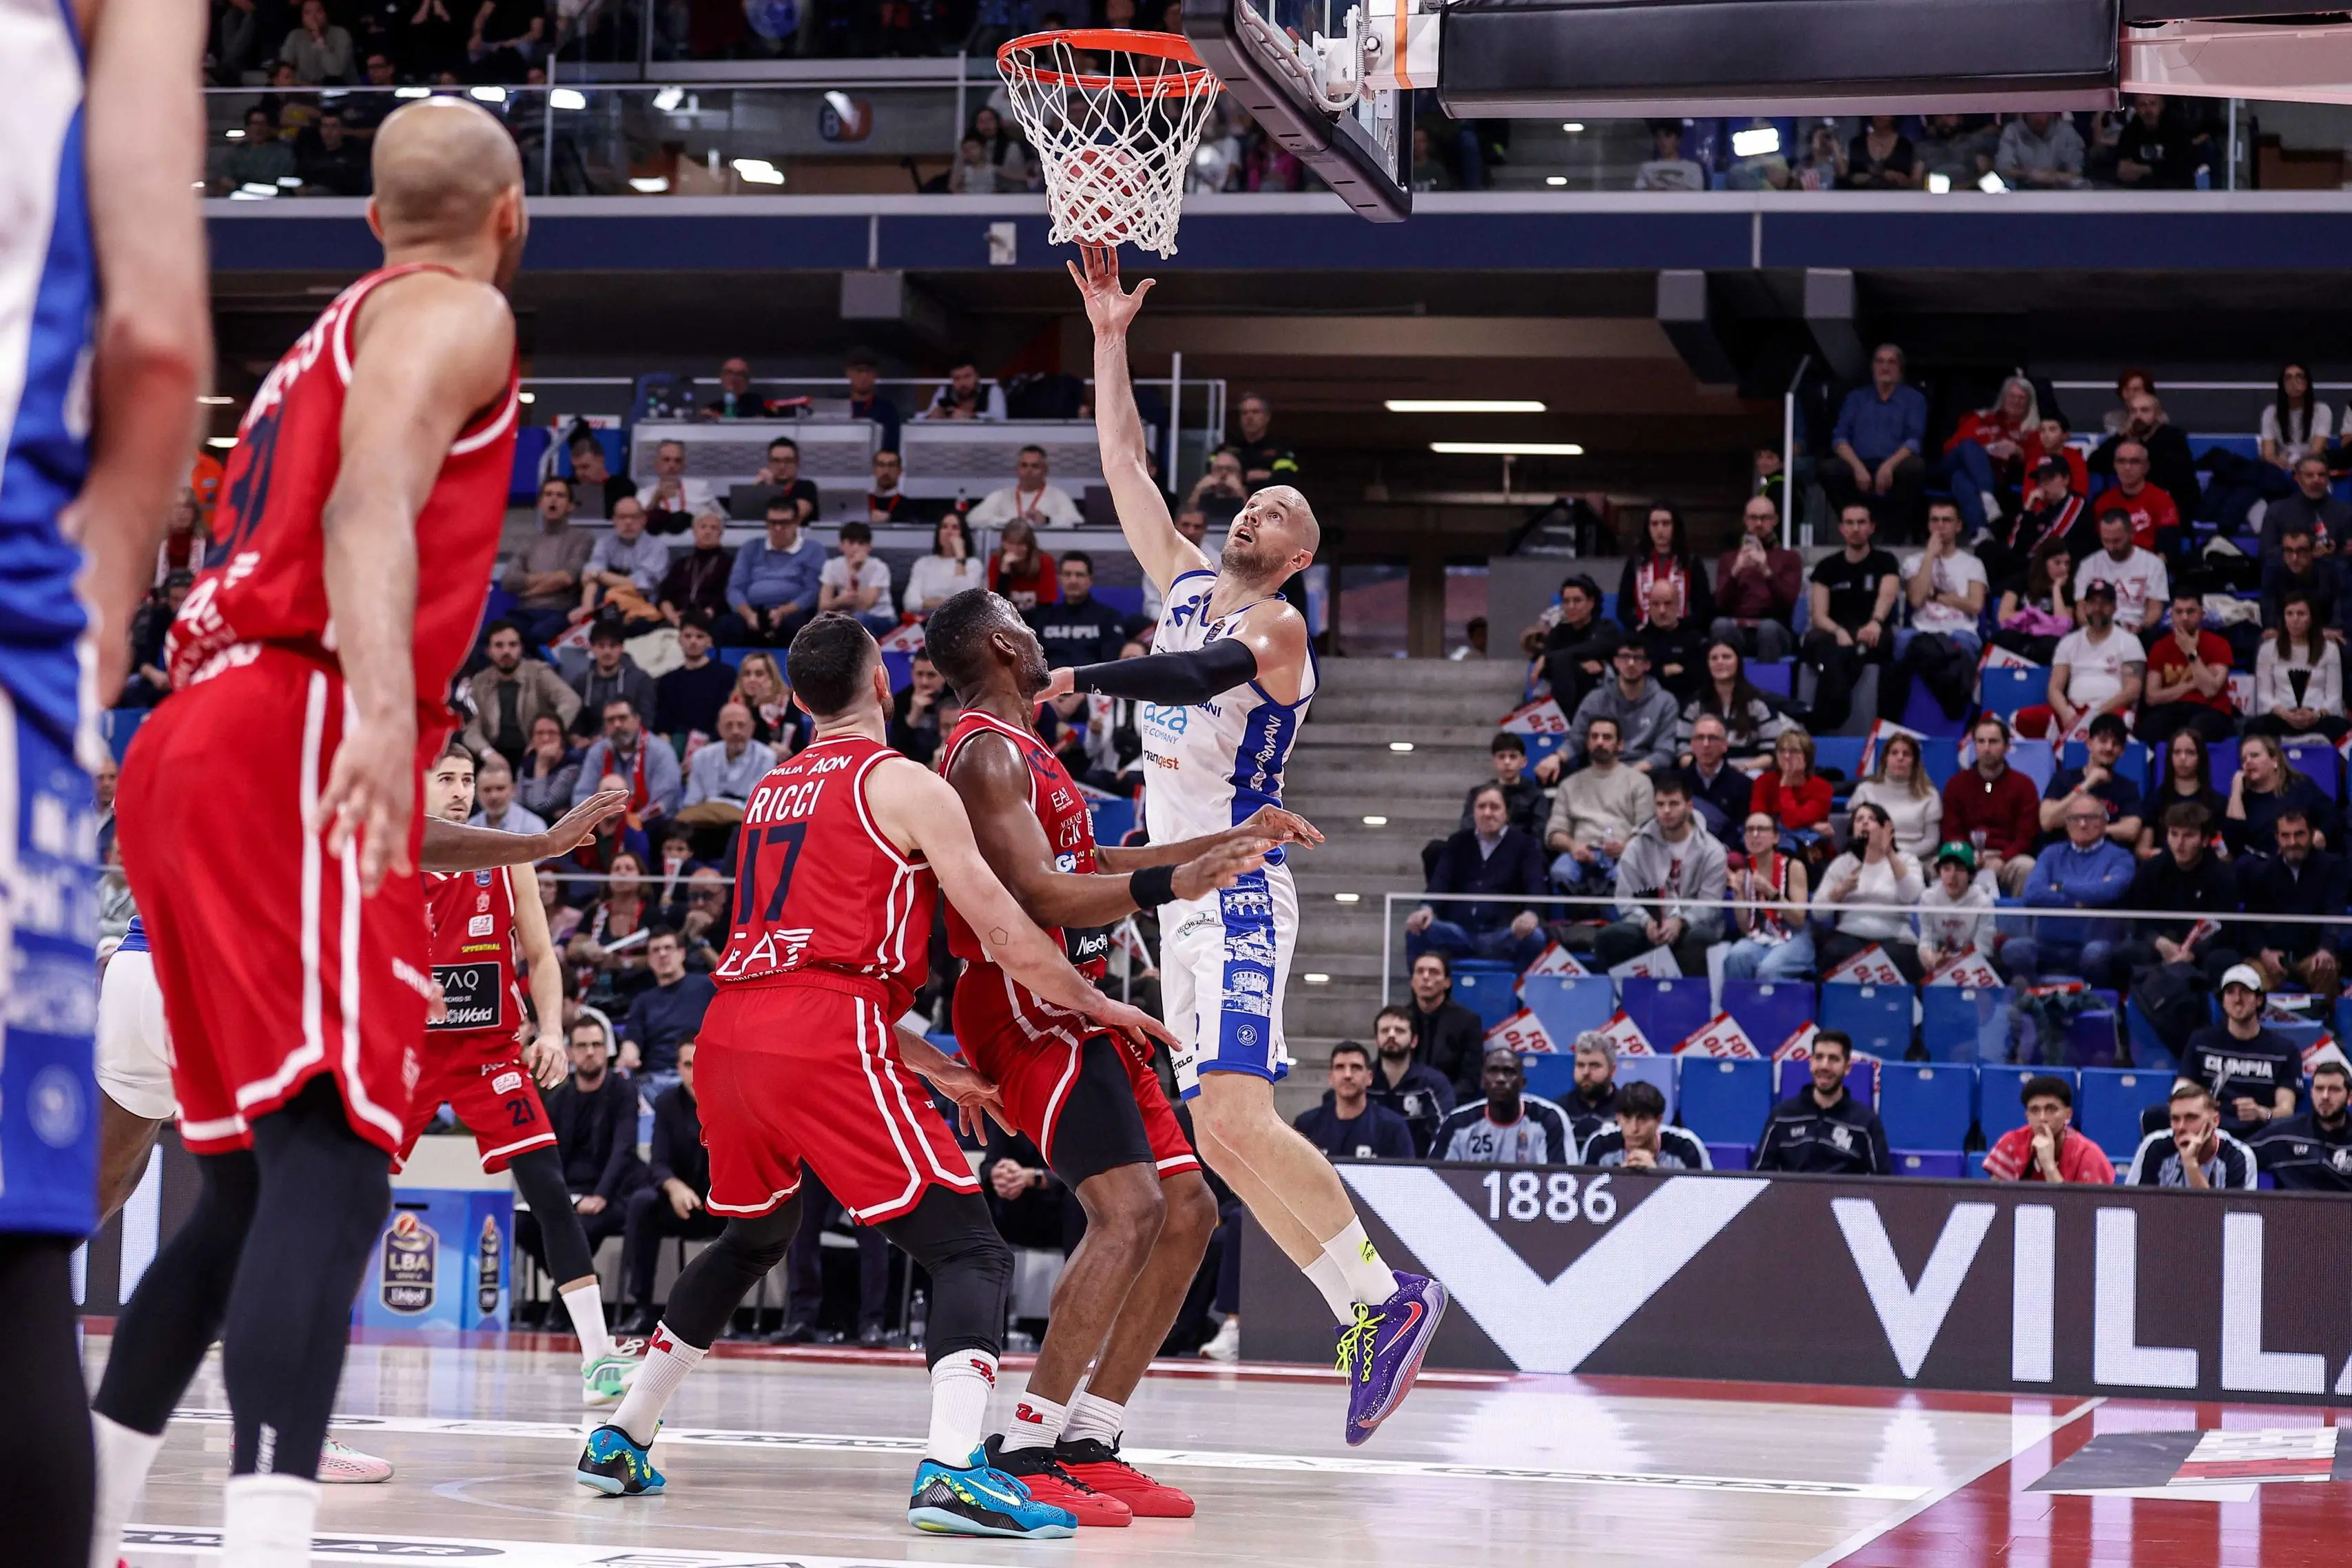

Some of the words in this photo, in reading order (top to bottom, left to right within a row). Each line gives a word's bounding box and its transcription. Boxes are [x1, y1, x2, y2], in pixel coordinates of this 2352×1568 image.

[806, 755, 854, 776] AON
[745, 778, 825, 825] RICCI
[736, 821, 808, 926] 17
[506, 1097, 536, 1126] 21
[1472, 1133, 1494, 1155] 25
[1483, 1169, 1618, 1226] 1886
[389, 1252, 431, 1272] LBA
[1830, 1196, 2352, 1397] VILL
